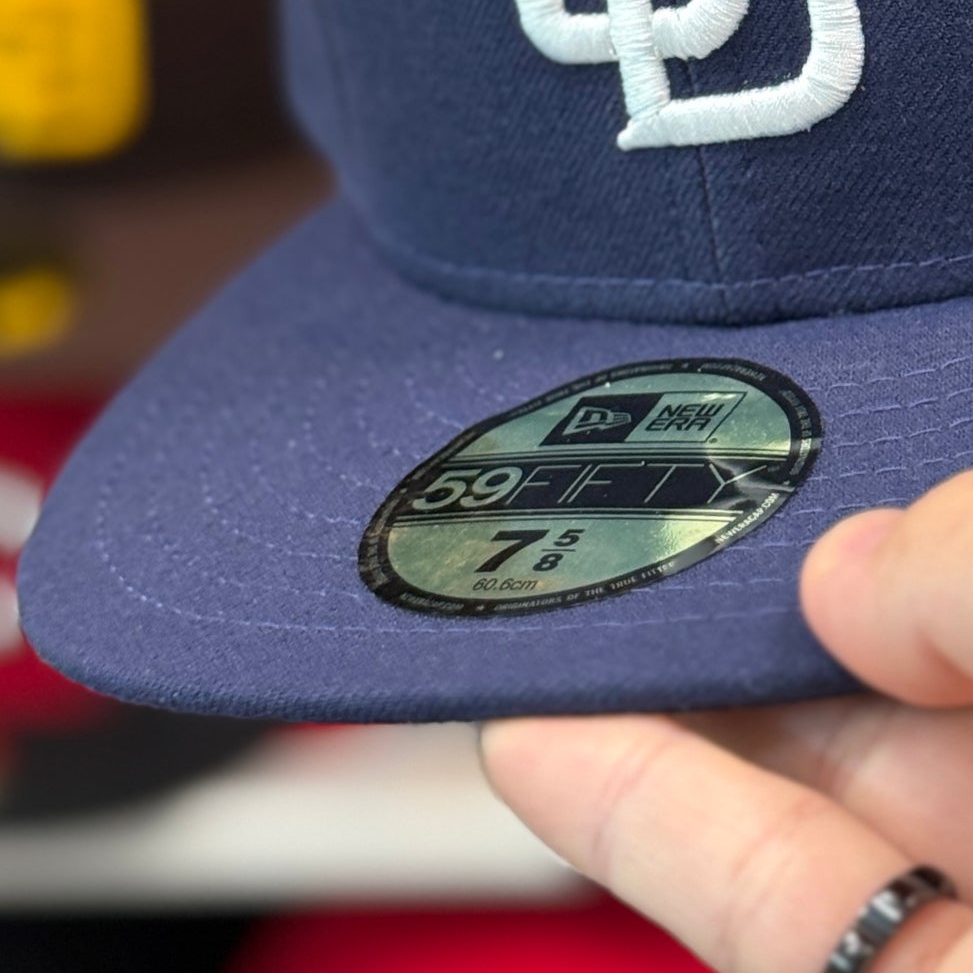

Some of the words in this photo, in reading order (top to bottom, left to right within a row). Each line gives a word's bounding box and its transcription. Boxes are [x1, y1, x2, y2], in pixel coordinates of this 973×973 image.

[657, 403, 725, 419] NEW
[644, 417, 711, 432] ERA
[473, 528, 551, 573] 7
[472, 577, 539, 592] 60.6cm
